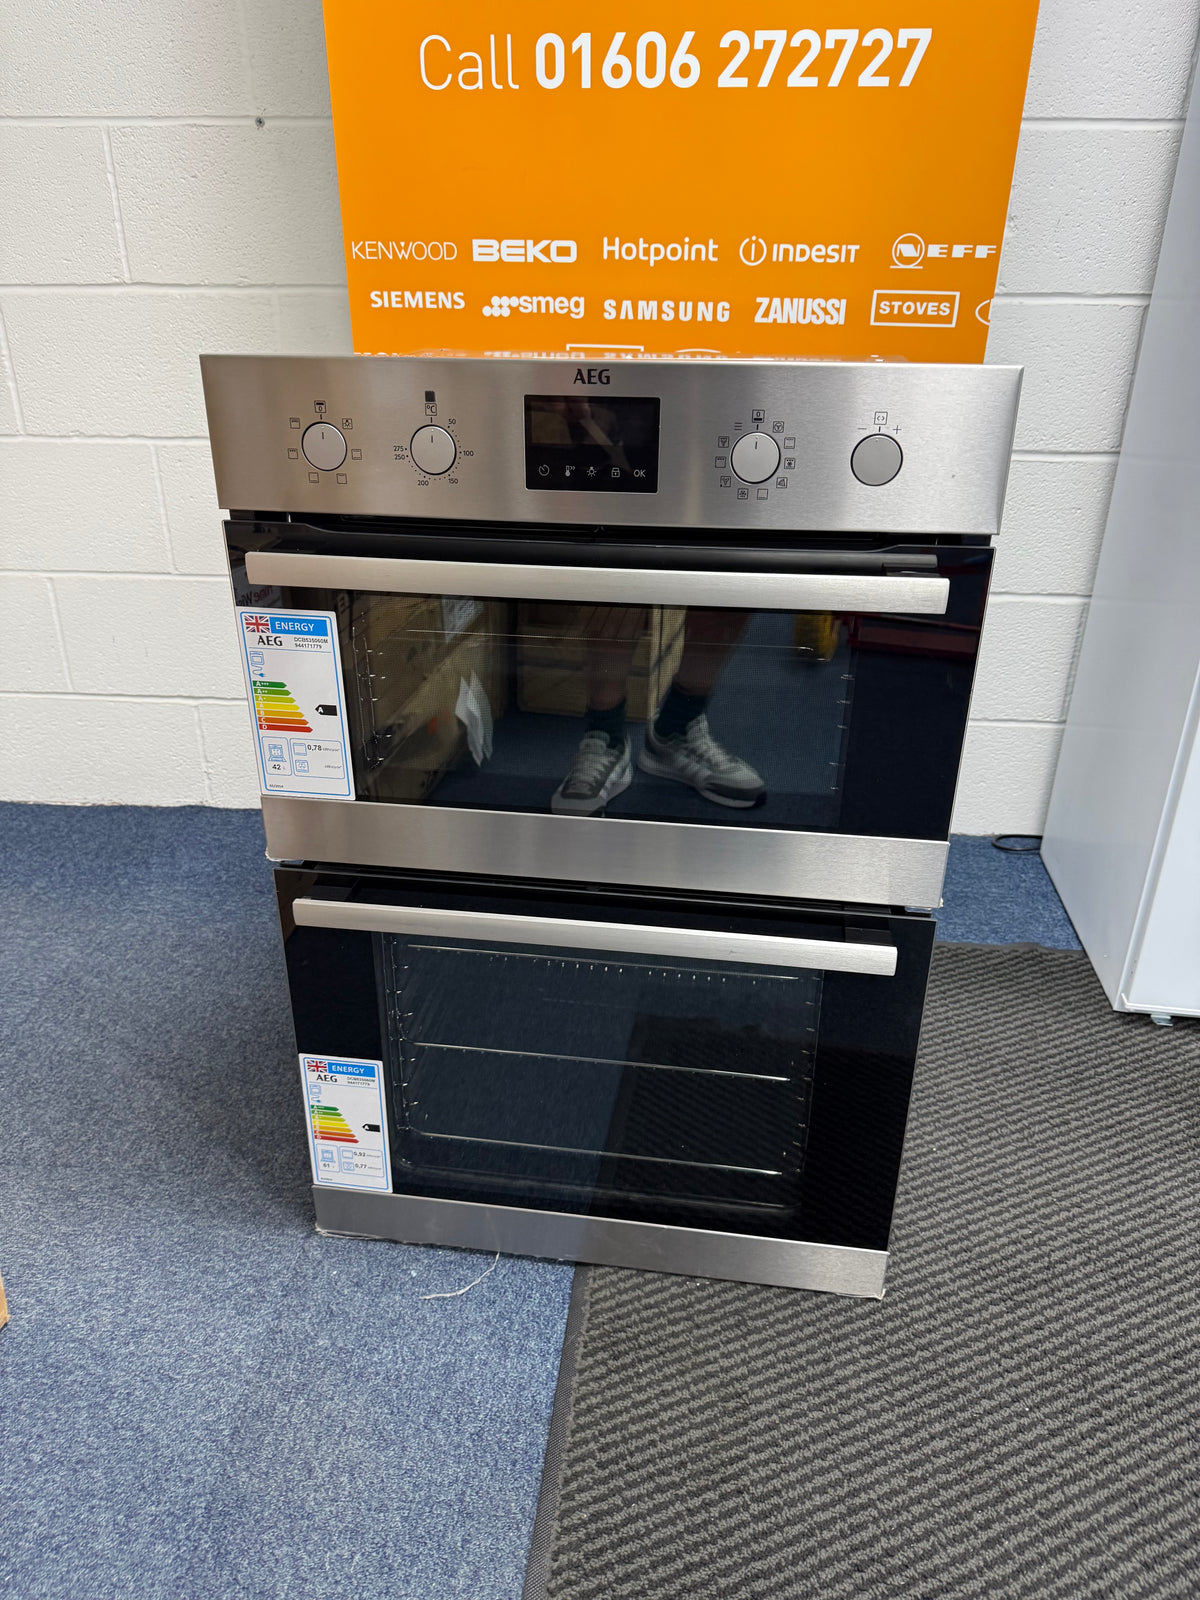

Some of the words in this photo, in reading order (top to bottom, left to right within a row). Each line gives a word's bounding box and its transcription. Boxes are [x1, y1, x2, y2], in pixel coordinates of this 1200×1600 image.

[419, 33, 520, 91] Call
[535, 30, 701, 90] 01606
[717, 27, 933, 88] 272727
[351, 241, 458, 261] KENWOOD
[472, 239, 578, 263] BEKO
[602, 236, 719, 267] Hotpoint
[893, 240, 997, 260] NEFF
[369, 290, 466, 309] SIEMENS
[518, 295, 585, 320] smeg
[878, 301, 951, 317] STOVES
[603, 299, 731, 322] SAMSUNG
[754, 297, 847, 326] ZANUSSI
[573, 368, 611, 385] AEG
[633, 469, 646, 478] OK
[275, 621, 315, 632] ENERGY
[257, 635, 283, 647] AEG
[318, 706, 324, 714] A
[316, 1074, 338, 1083] AEG
[332, 1064, 365, 1074] ENERGY
